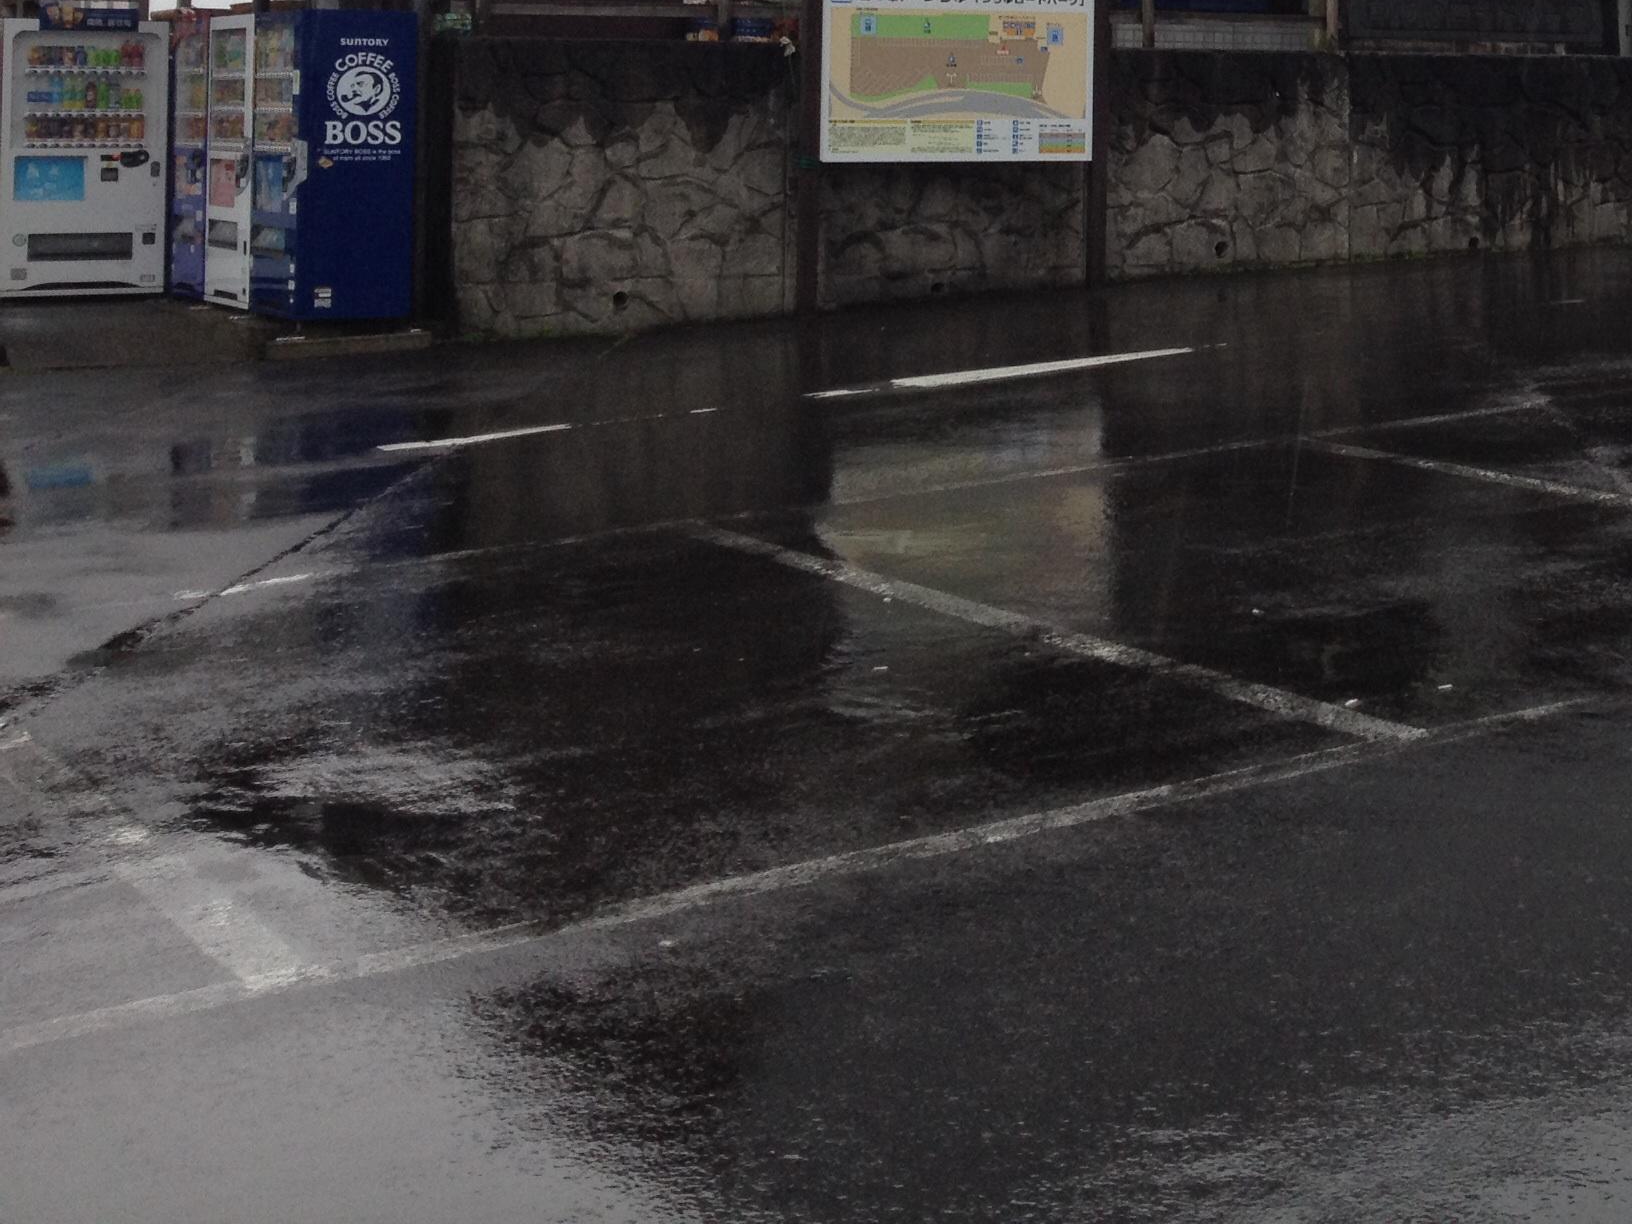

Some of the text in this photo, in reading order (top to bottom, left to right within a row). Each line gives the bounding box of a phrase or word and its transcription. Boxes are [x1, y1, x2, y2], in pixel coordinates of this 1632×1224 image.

[340, 38, 389, 46] SUNTORY
[335, 52, 394, 73] COFFEE
[324, 120, 402, 145] BOSS
